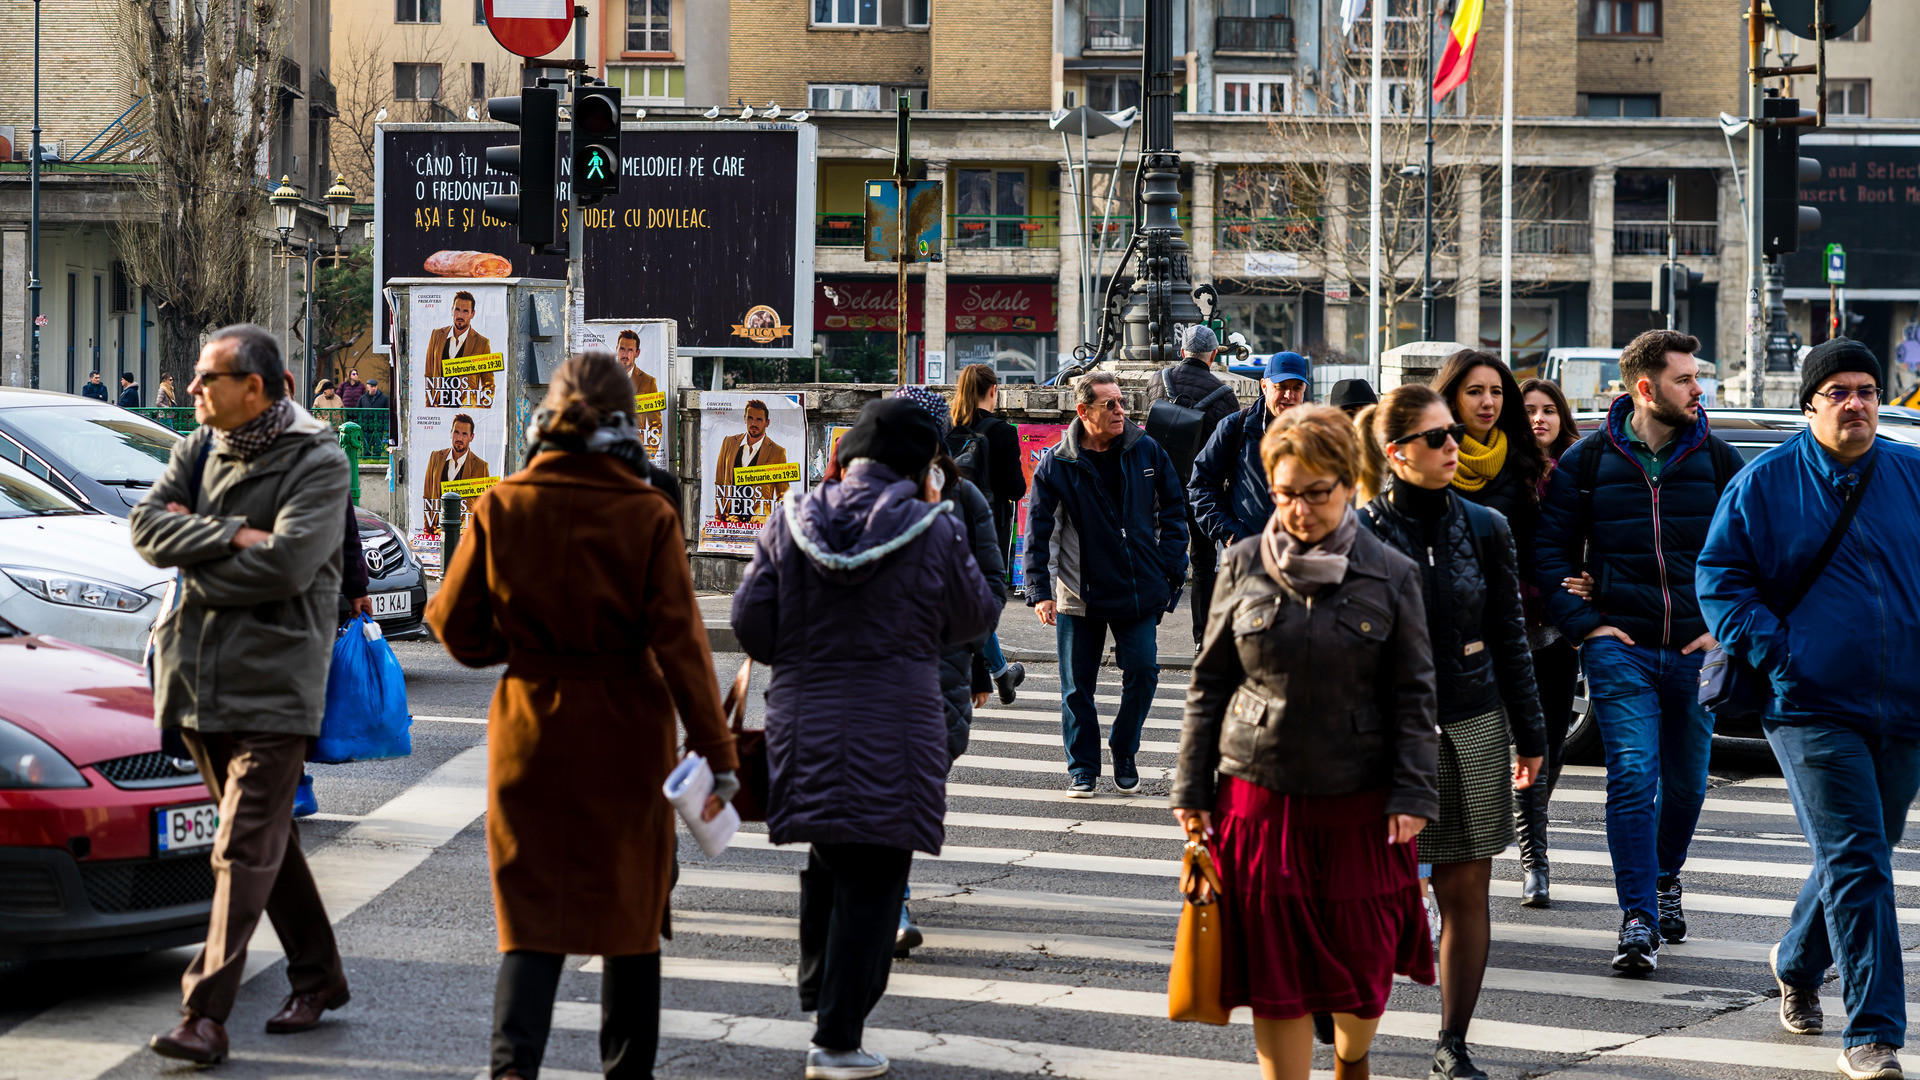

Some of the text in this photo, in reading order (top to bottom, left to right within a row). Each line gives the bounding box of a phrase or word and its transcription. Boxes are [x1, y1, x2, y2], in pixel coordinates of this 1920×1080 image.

[416, 152, 453, 176] CÂND
[622, 155, 746, 177] MELODIEI PE CARE
[1828, 161, 1857, 179] and
[415, 181, 425, 201] O
[1799, 186, 1847, 202] nsert
[1857, 185, 1896, 203] Boot
[415, 207, 440, 232] AȘA
[448, 208, 455, 228] E
[624, 208, 641, 228] CU
[648, 207, 712, 229] DOVLEAC.
[962, 285, 1031, 311] Selale
[747, 328, 776, 337] LUCA
[445, 366, 452, 375] 26
[487, 360, 502, 369] 19:30
[425, 376, 469, 390] NIKOS
[425, 389, 493, 407] VERTIS
[736, 475, 744, 483] 26
[782, 470, 798, 479] 19:30
[715, 485, 763, 499] NIKOS
[423, 498, 468, 513] NIS
[715, 497, 785, 516] VERTI
[705, 521, 725, 529] SALA
[376, 594, 407, 613] 13 KAJ
[173, 808, 214, 843] B 63
